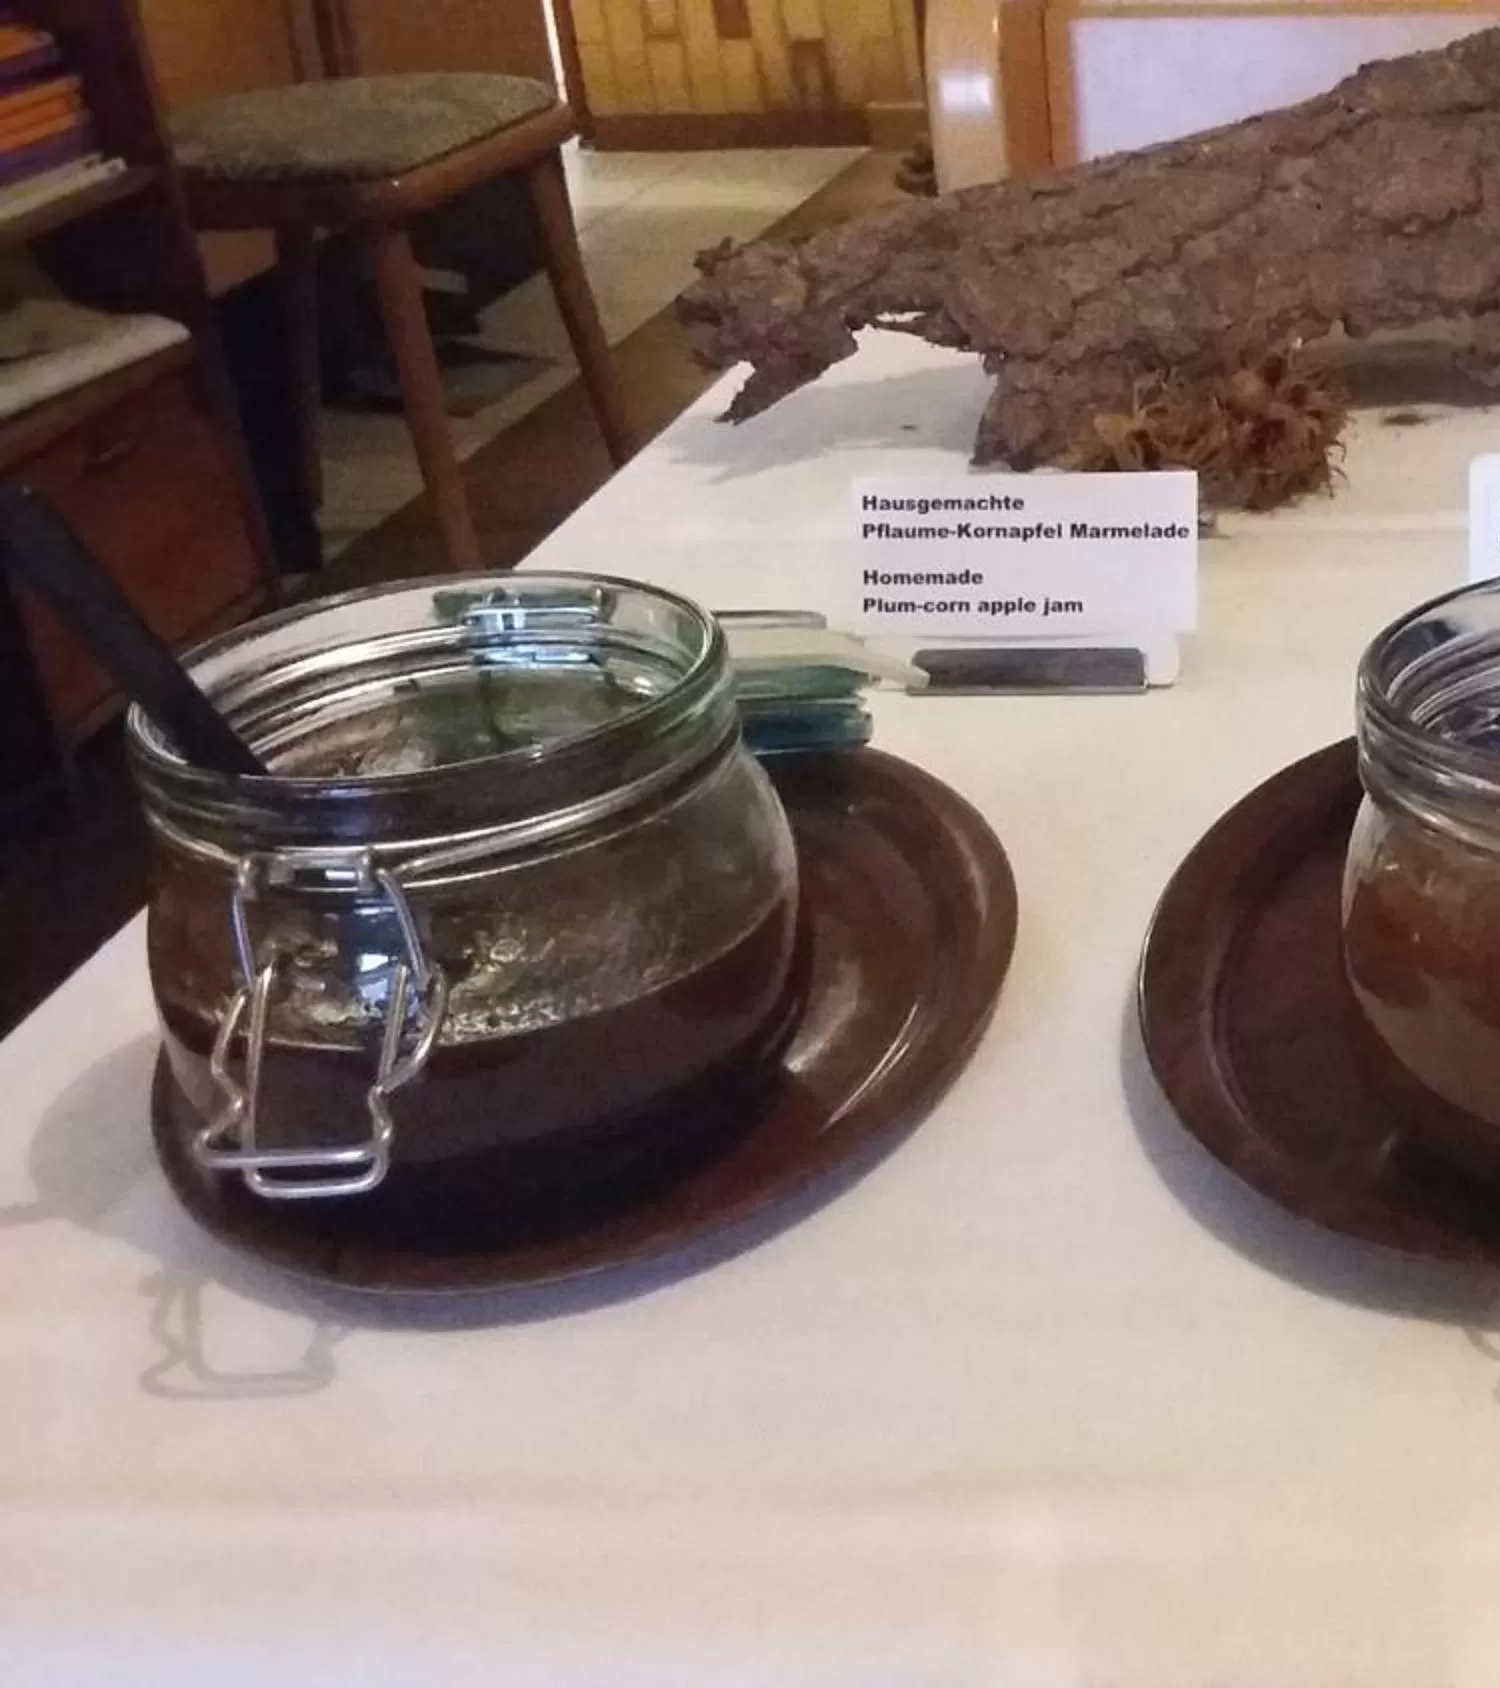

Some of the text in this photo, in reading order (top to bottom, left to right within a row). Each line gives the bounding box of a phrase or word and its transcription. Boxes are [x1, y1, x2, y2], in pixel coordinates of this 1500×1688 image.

[862, 495, 1025, 515] Hausgemachte
[862, 522, 1190, 542] Pflaume-Kornapfel Marmelade
[863, 568, 984, 585] Homemade
[863, 597, 1083, 616] Plum-corn apple jam
